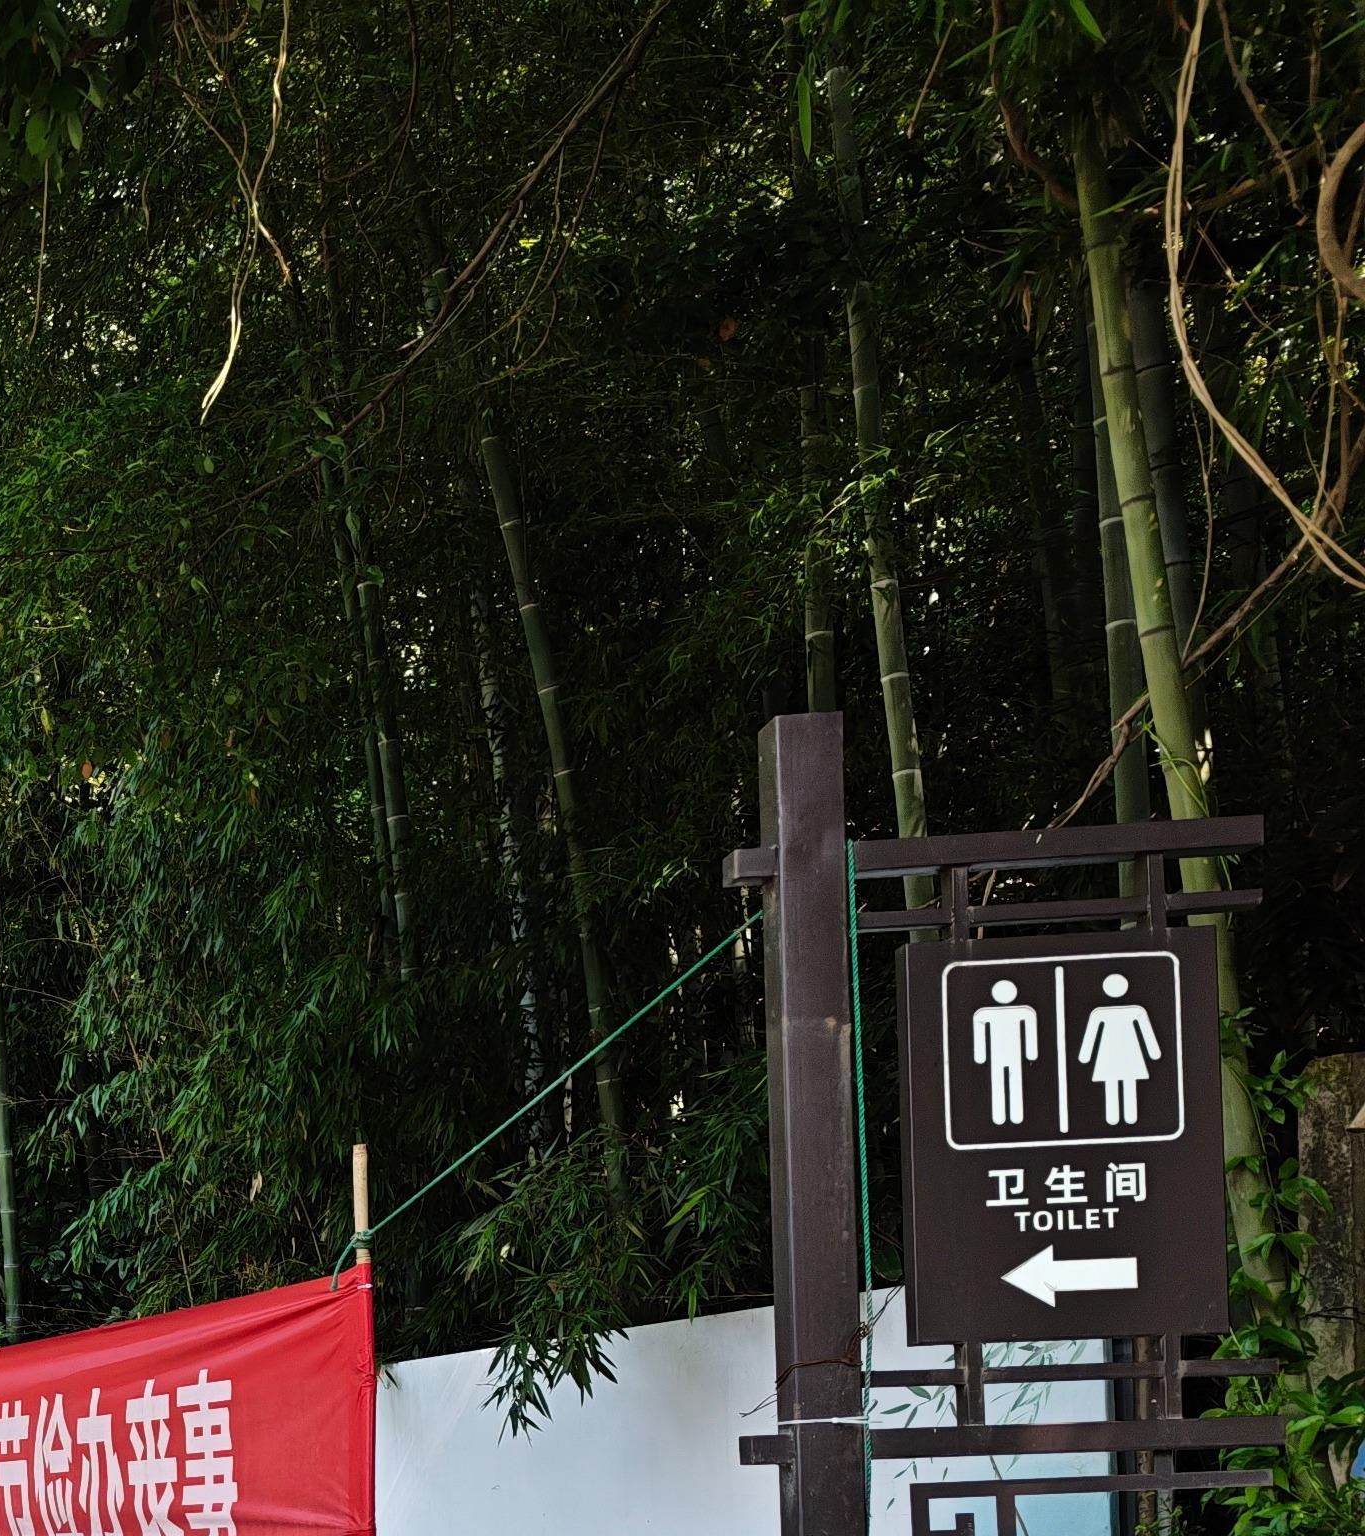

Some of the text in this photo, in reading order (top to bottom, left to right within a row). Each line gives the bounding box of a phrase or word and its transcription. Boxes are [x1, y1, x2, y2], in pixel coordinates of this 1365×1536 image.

[985, 1162, 1147, 1207] 卫生间
[1014, 1207, 1120, 1232] TOILET
